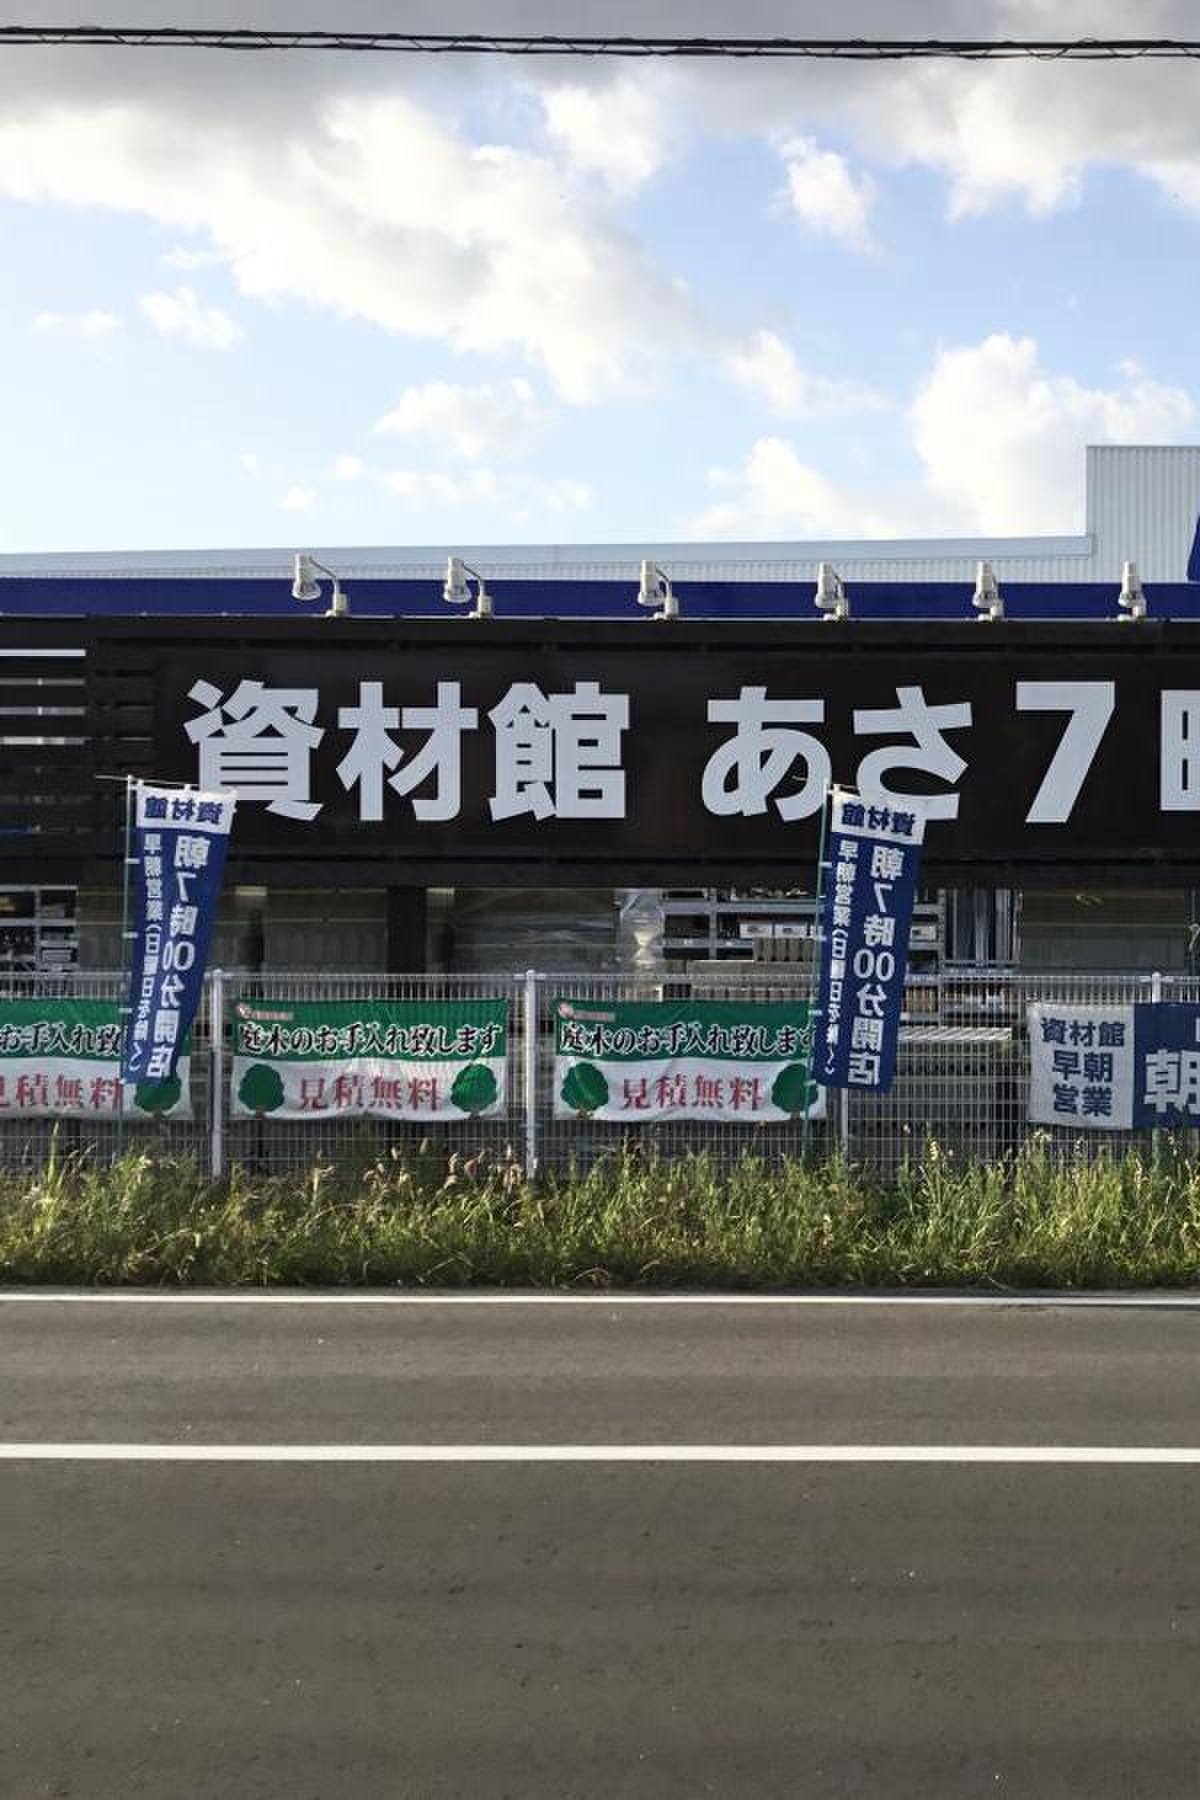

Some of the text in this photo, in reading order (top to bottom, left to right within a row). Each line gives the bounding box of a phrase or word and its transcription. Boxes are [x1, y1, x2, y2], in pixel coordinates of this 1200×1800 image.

[183, 679, 630, 821] 資材館
[238, 1022, 502, 1057] 庭木のお手入れ致します
[1040, 1017, 1125, 1048] 資材館
[1052, 1050, 1114, 1081] 早朝
[301, 1074, 440, 1110] 見積無料
[622, 1073, 762, 1111] 見積無料
[1051, 1083, 1114, 1117] 営業
